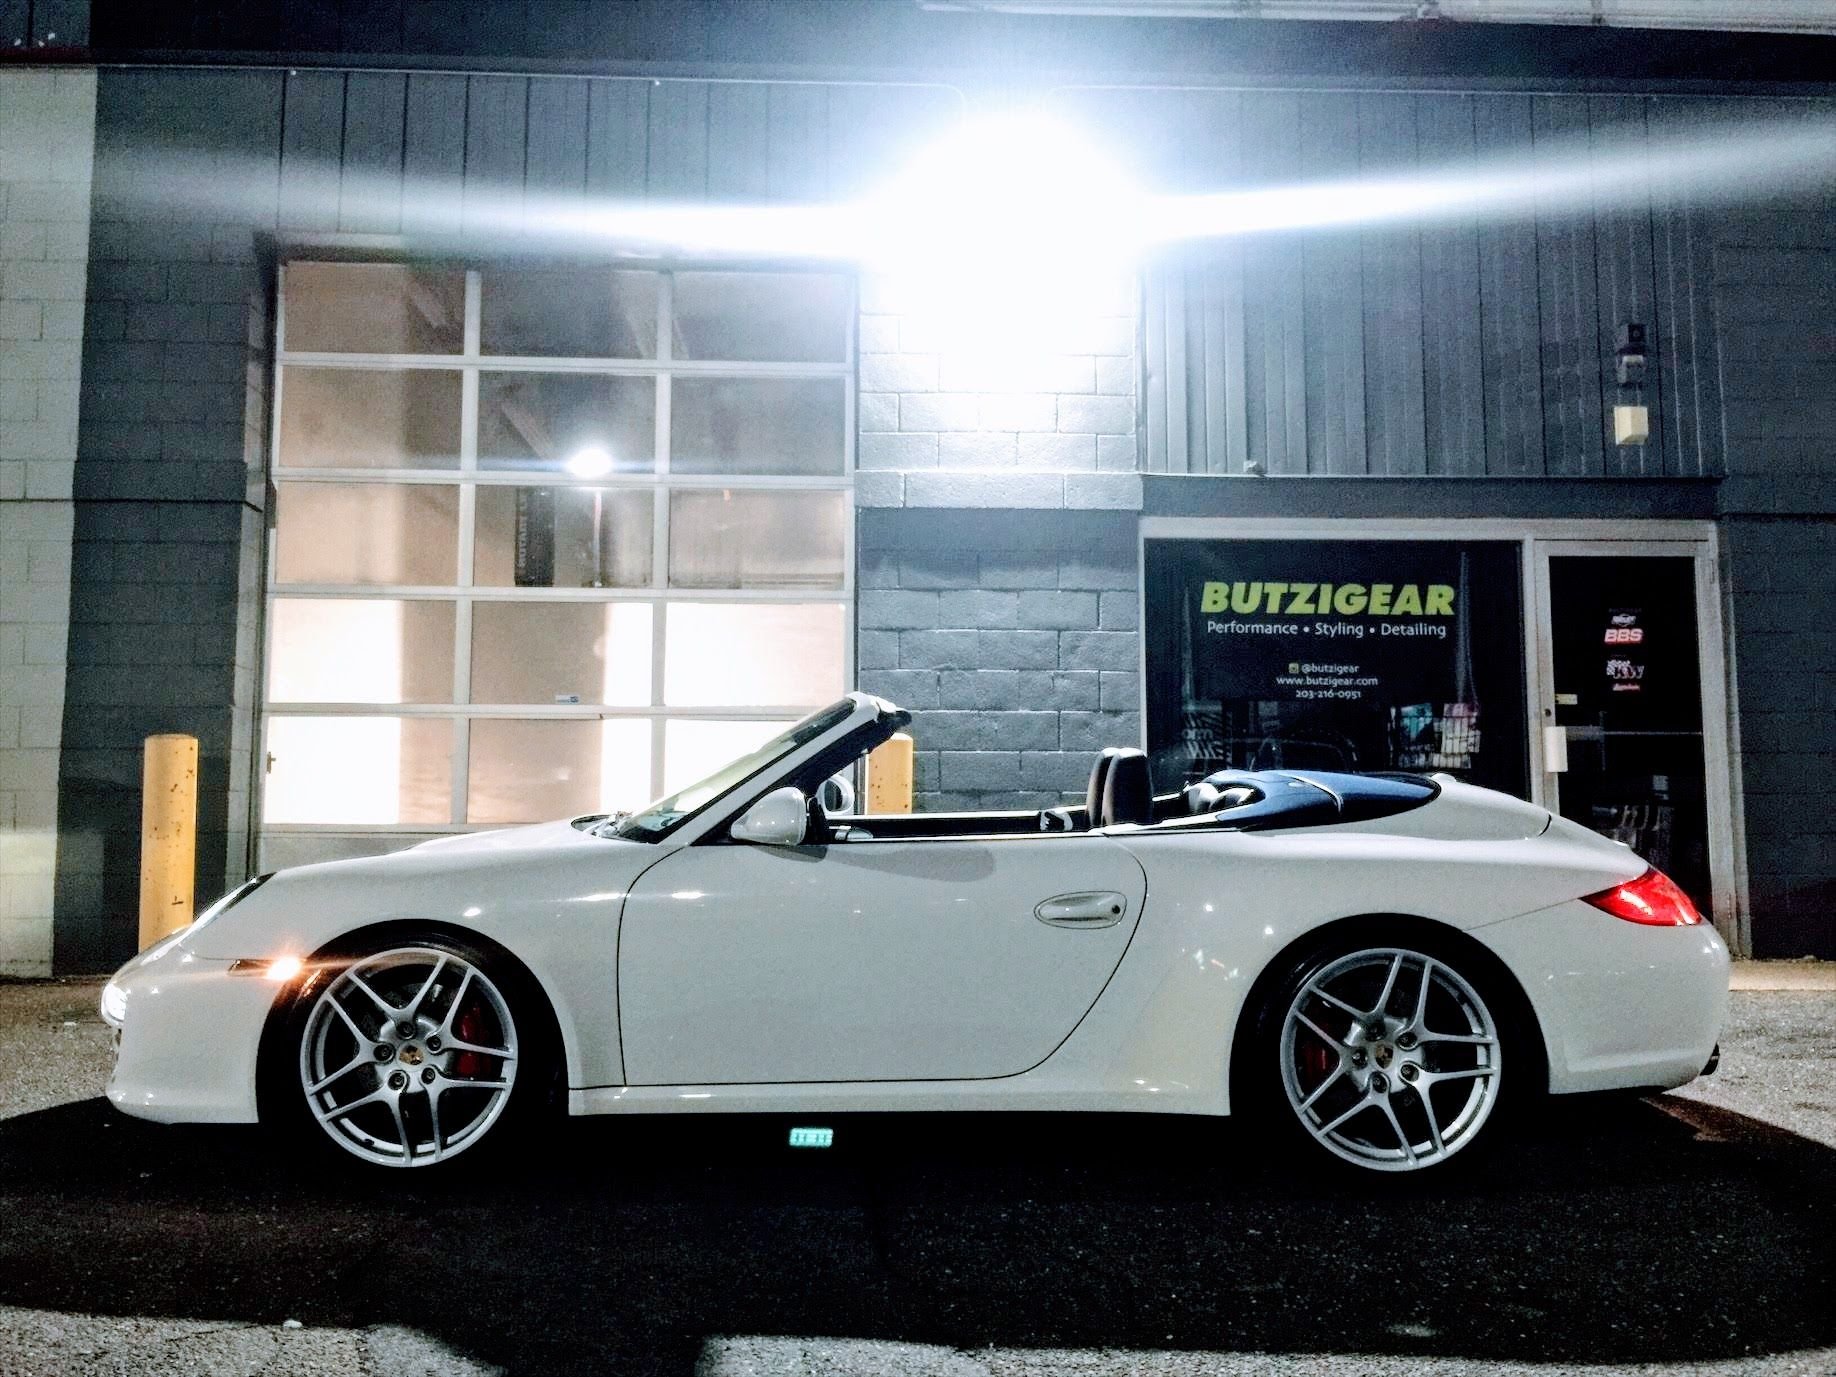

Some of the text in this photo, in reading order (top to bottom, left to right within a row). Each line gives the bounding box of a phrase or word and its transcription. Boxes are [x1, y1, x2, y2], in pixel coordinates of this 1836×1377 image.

[1200, 581, 1456, 615] BUTZIGEAR
[1207, 620, 1447, 639] Performance Styling Detailing
[1604, 628, 1643, 643] BBS
[1301, 662, 1360, 675] @butzigear
[1276, 676, 1378, 687] www.butzigear.com
[1295, 688, 1361, 699] 203-216-0951
